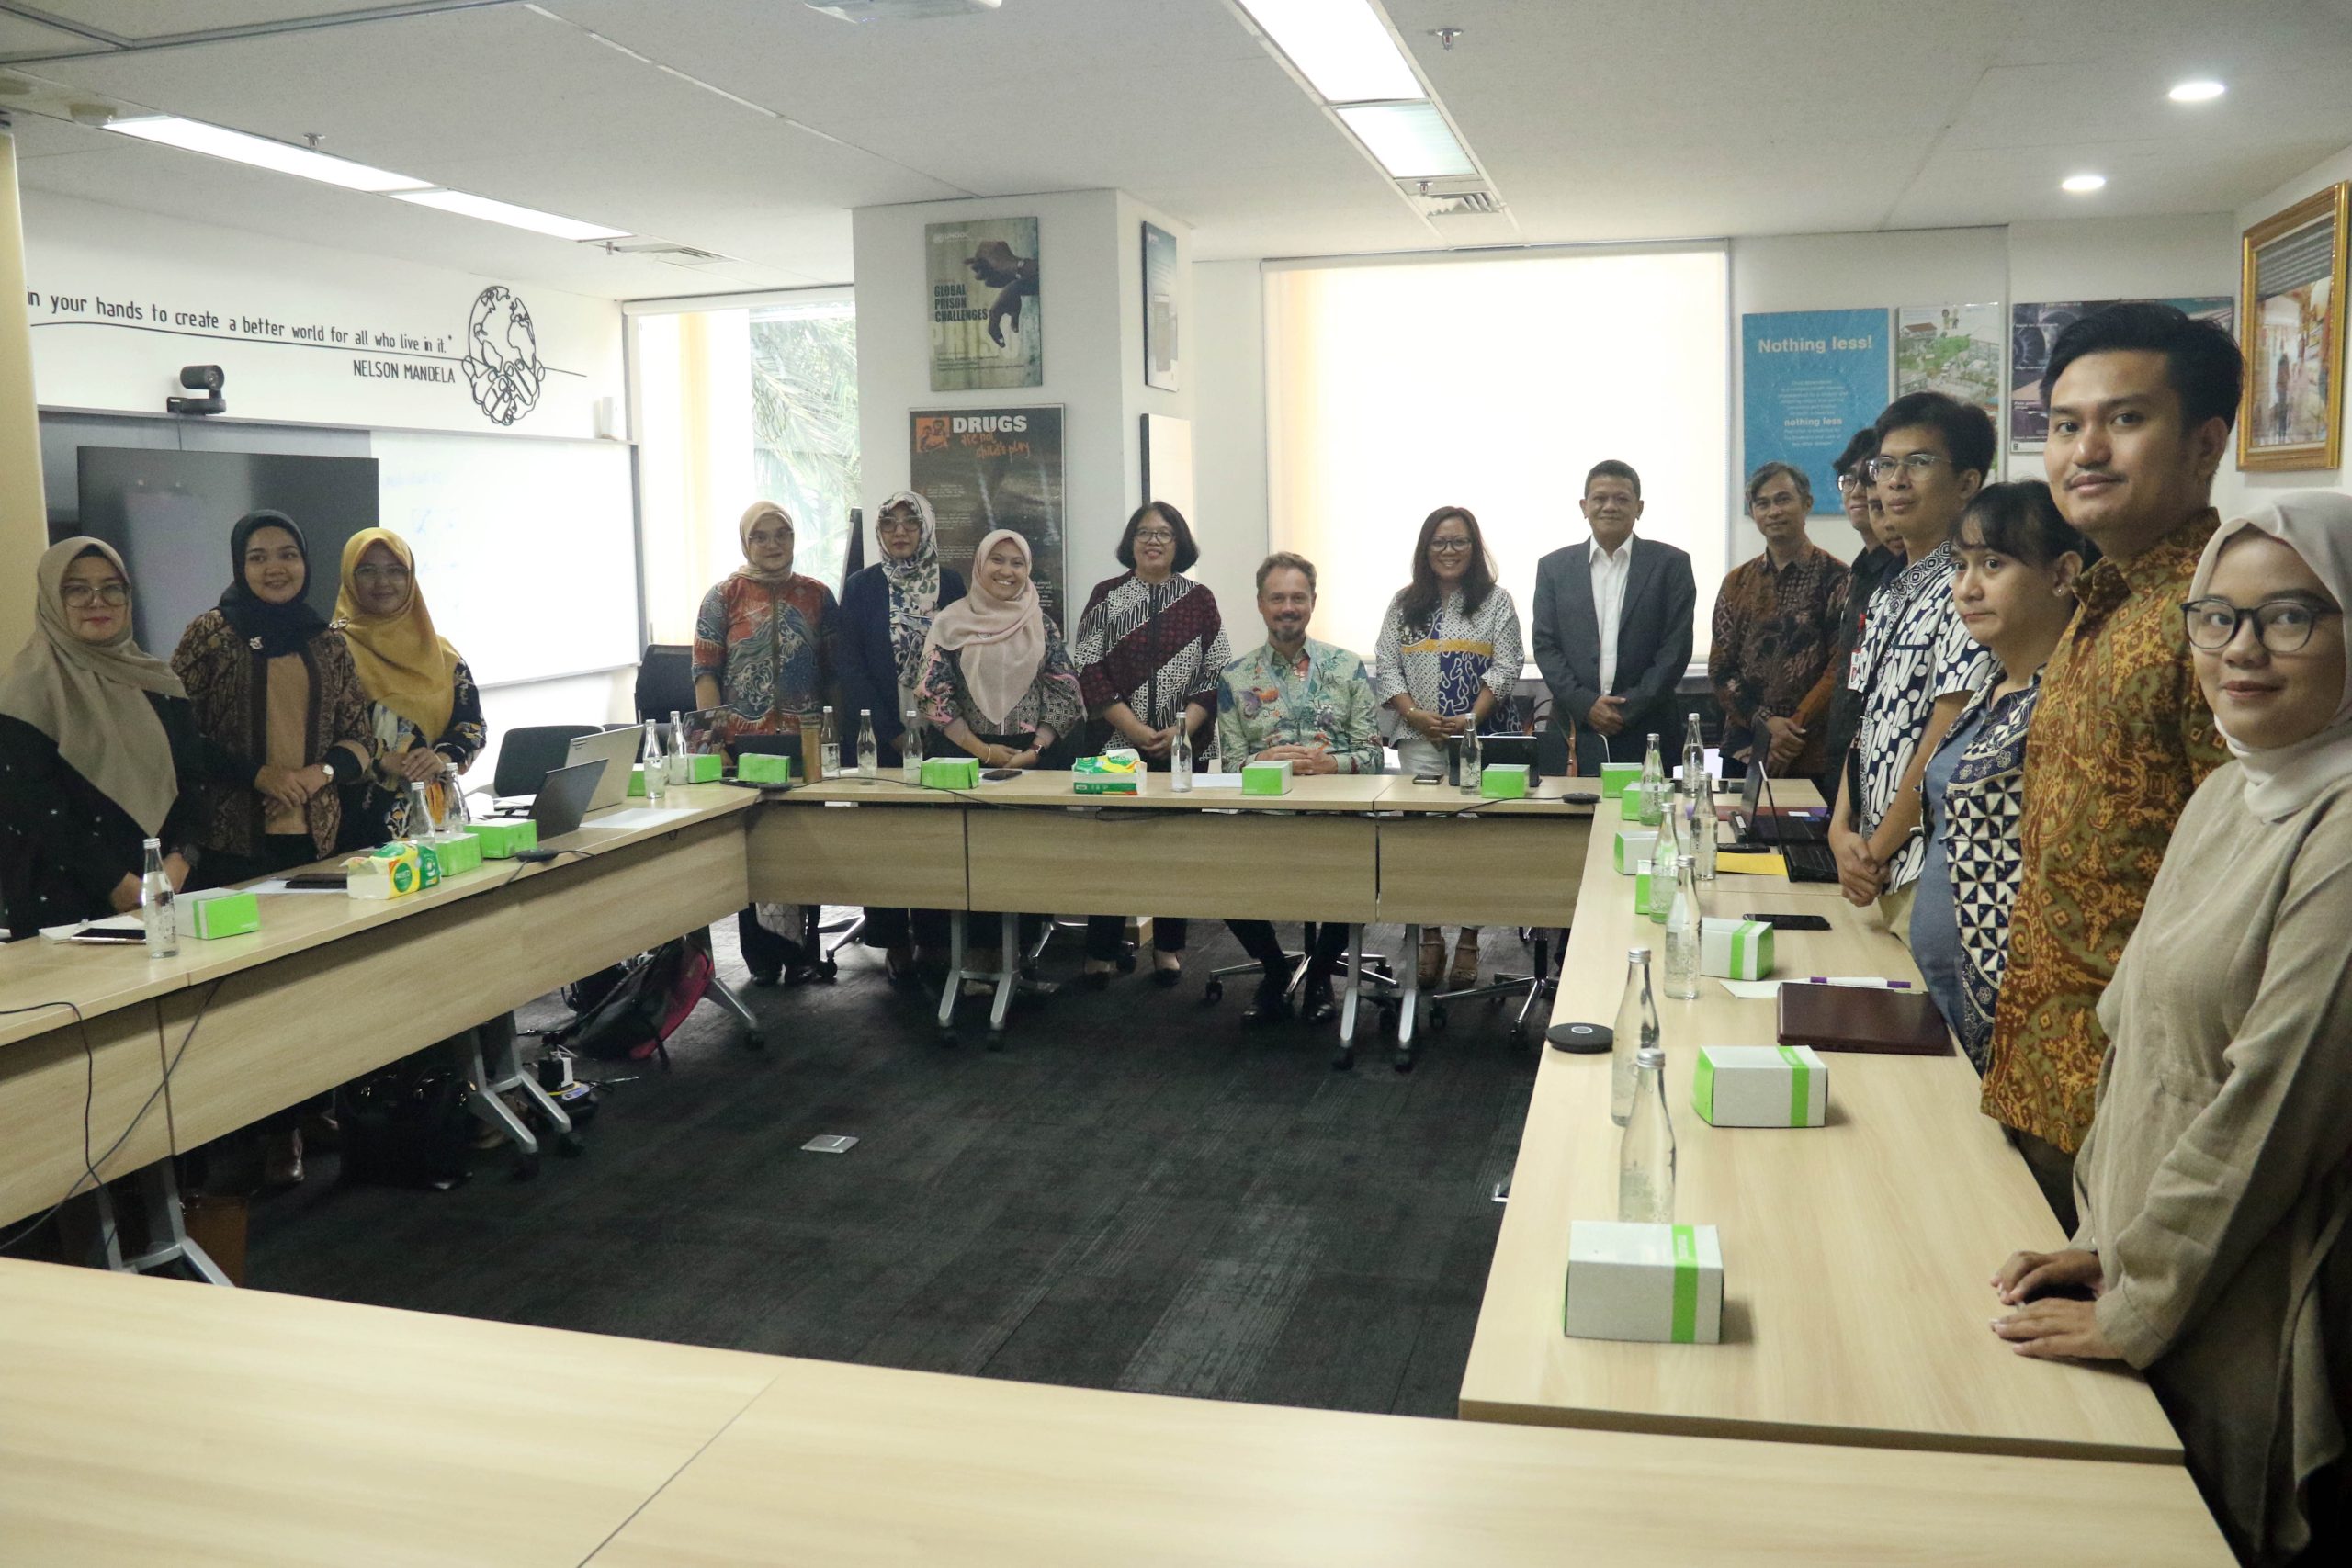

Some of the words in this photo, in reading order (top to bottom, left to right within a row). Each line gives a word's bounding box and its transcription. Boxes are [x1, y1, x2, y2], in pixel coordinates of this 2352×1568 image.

[934, 284, 967, 297] GLOBAL
[934, 297, 967, 310] PRISON
[27, 286, 40, 306] in
[51, 294, 87, 314] your
[96, 296, 143, 320] hands
[153, 304, 168, 322] to
[175, 310, 220, 329] create
[229, 318, 236, 331] a
[243, 316, 285, 336] better
[291, 325, 324, 342] world
[331, 326, 349, 344] for
[355, 330, 368, 345] all
[374, 332, 396, 348] who
[401, 334, 420, 351] live
[424, 335, 433, 352] in
[934, 309, 989, 322] CHALLENGES
[1758, 337, 1826, 354] Nothing
[1832, 334, 1872, 350] less!
[353, 359, 399, 378] NELSON
[403, 363, 456, 383] MANDELA
[953, 415, 1028, 434] DRUGS
[1784, 417, 1819, 427] nothing
[1823, 416, 1843, 425] less
